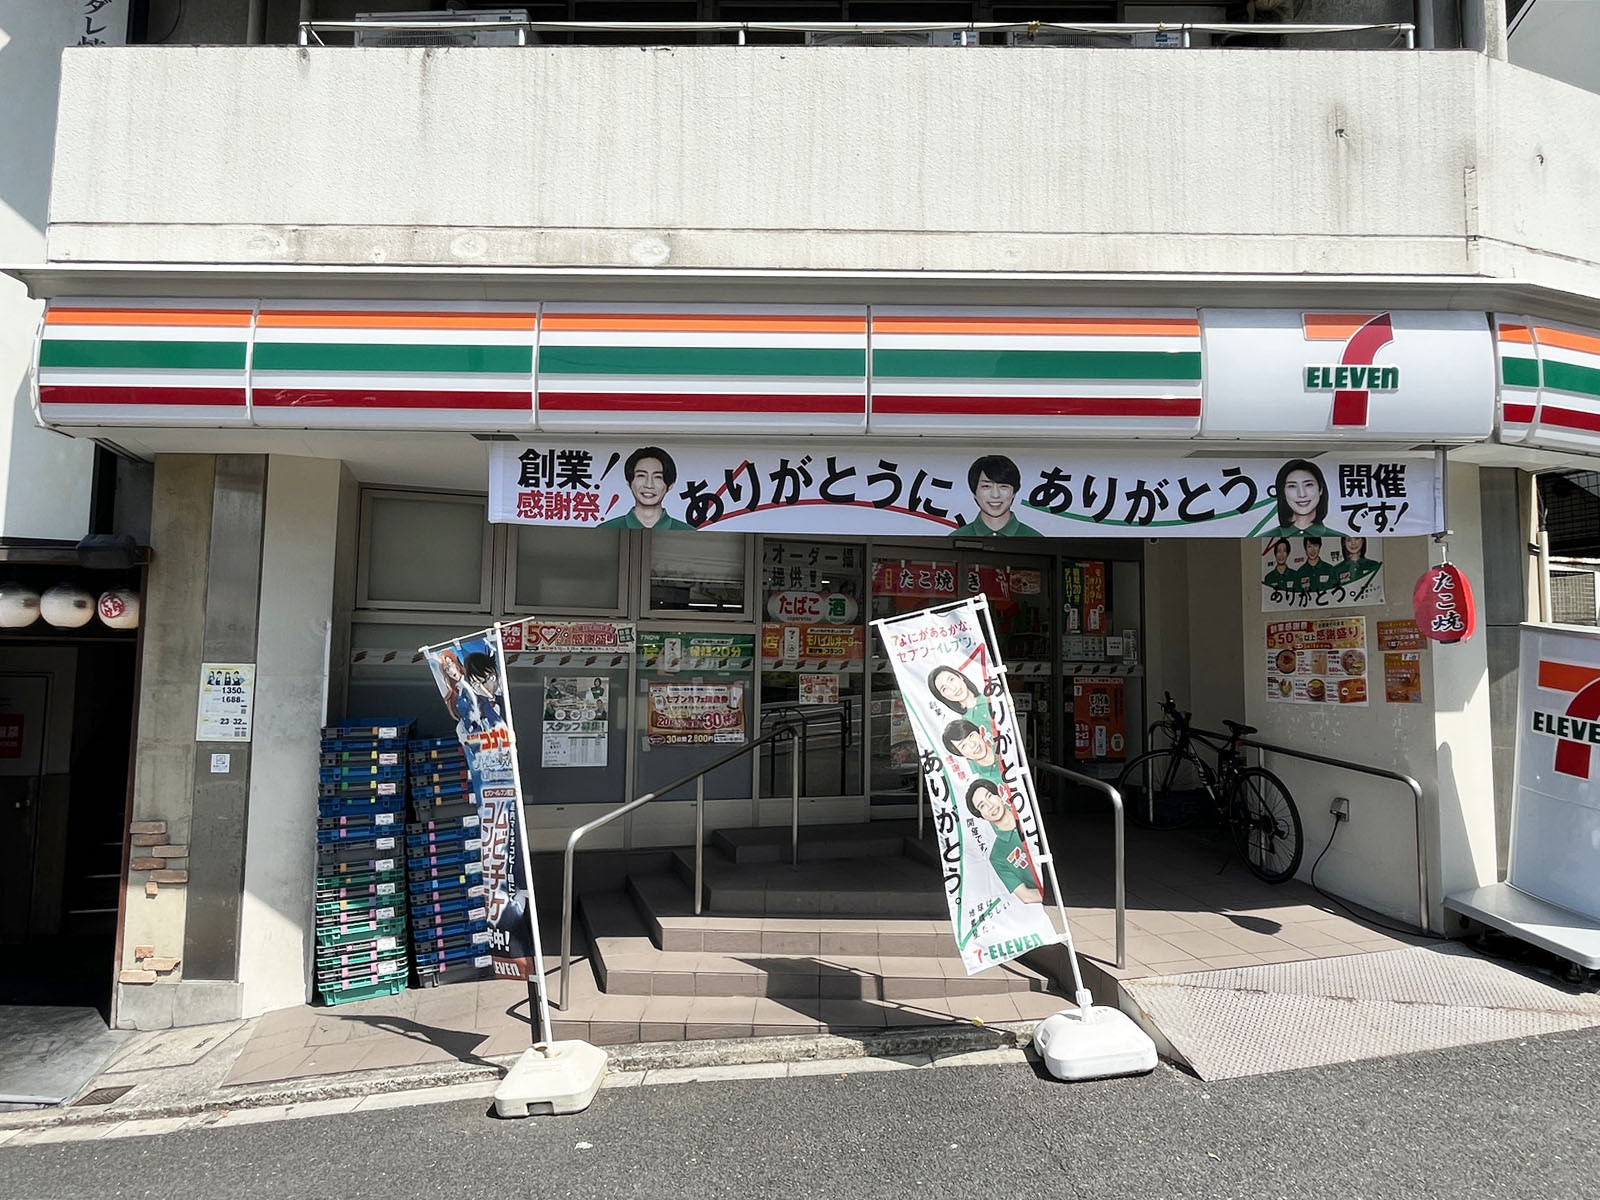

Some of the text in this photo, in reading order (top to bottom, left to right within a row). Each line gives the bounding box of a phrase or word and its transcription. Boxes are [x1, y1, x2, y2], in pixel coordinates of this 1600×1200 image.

[78, 0, 112, 47] ダレ
[1303, 312, 1394, 426] 7
[680, 456, 966, 529] ありがとうに、
[1028, 465, 1279, 527] ありがとう。
[1338, 463, 1407, 498] 開催
[516, 490, 621, 522] 感謝祭!
[1340, 500, 1410, 533] です!
[779, 595, 821, 616] たばこ
[828, 598, 847, 617] 酒
[1270, 583, 1357, 607] ありがとう。
[1431, 570, 1465, 633] たこ焼
[546, 722, 605, 732] スタッフ募集!
[920, 749, 962, 905] ありがとう。
